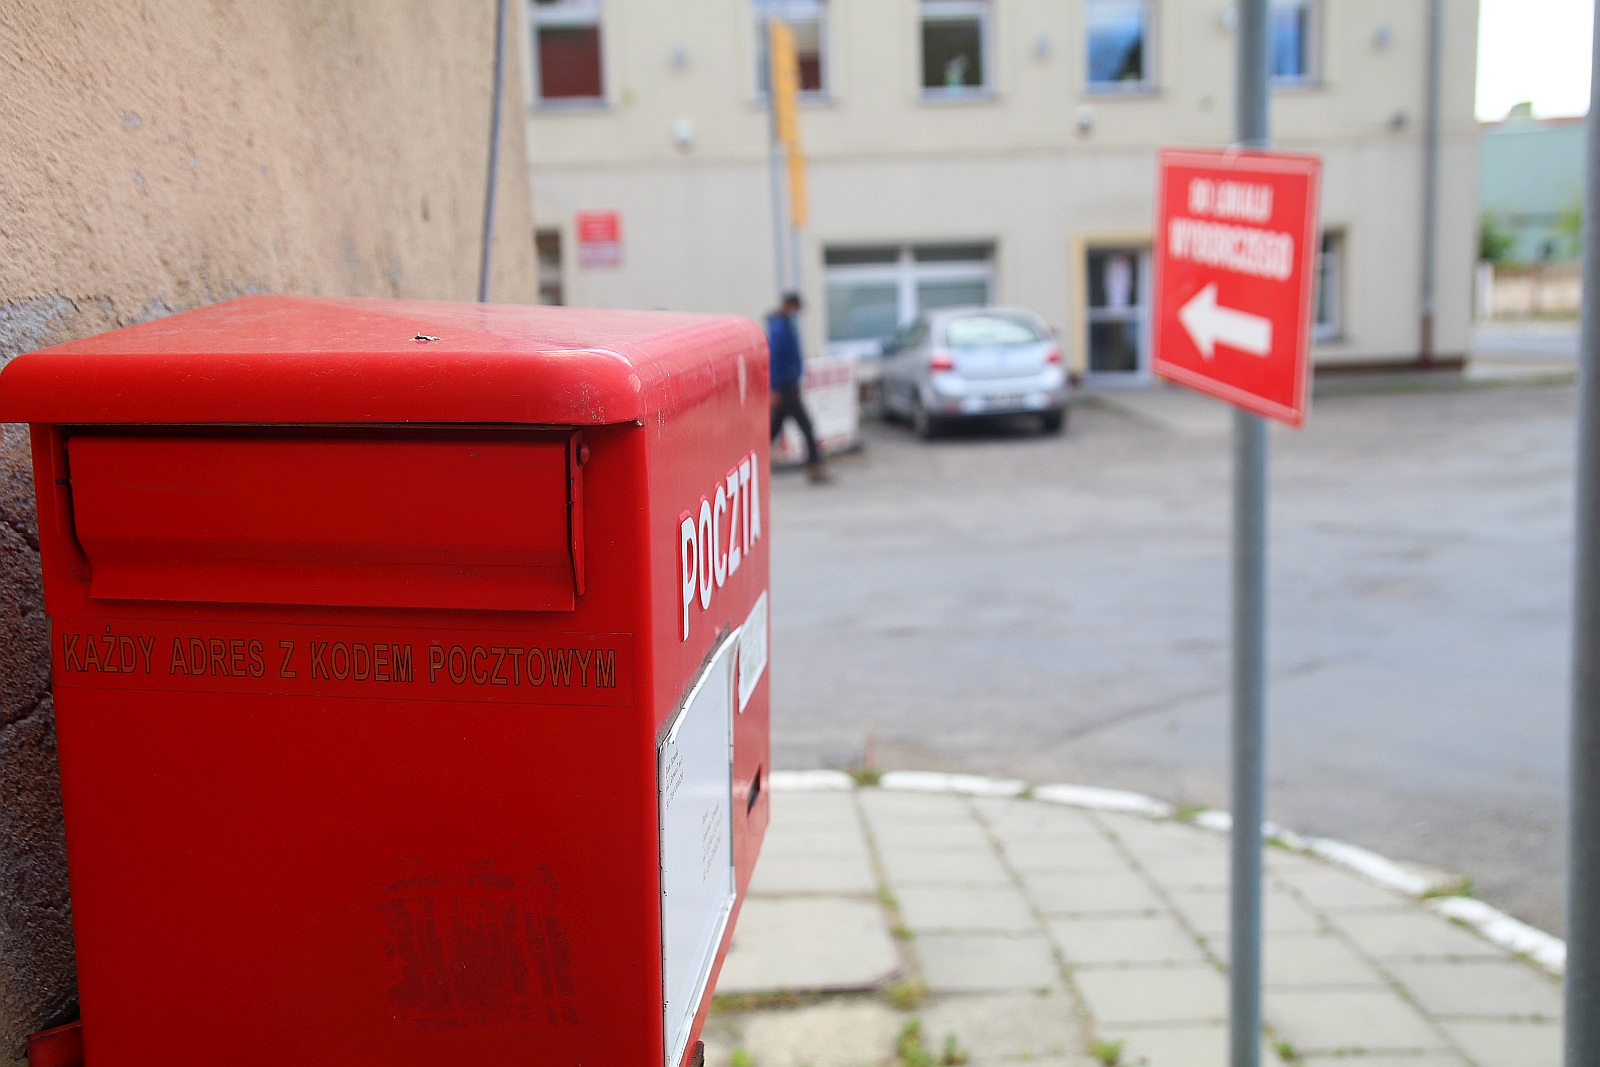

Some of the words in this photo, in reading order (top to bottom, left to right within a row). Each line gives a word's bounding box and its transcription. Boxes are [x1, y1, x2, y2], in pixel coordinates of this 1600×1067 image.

[677, 451, 761, 642] POCZTA
[62, 625, 155, 674] KAŻDY
[170, 637, 265, 678] ADRES
[279, 640, 296, 678] Z
[310, 641, 413, 683] KODEM
[428, 645, 616, 688] POCZTOWYM
